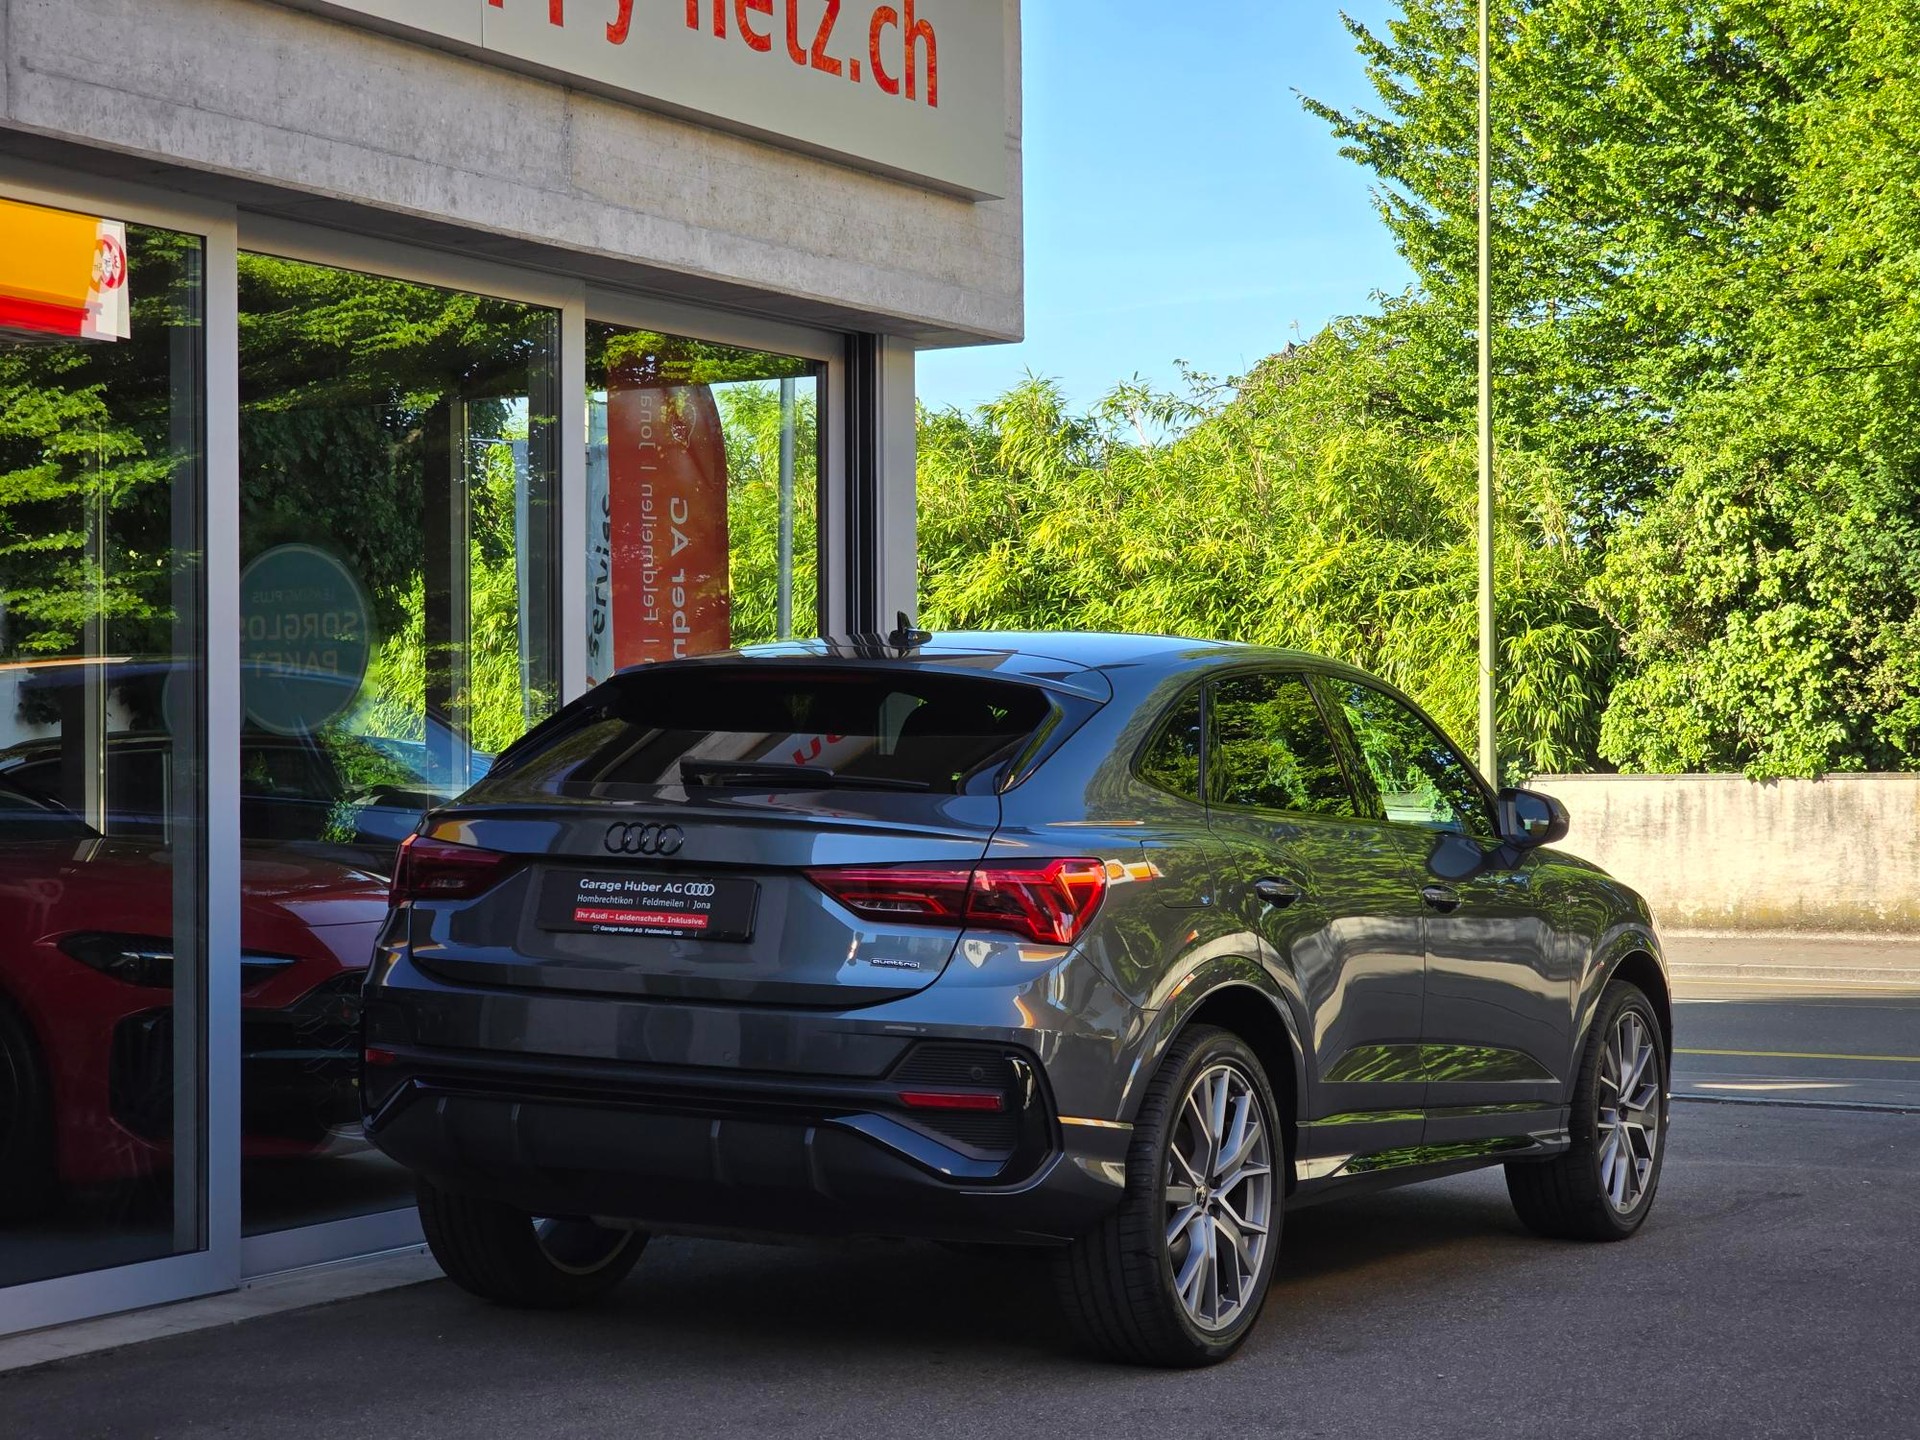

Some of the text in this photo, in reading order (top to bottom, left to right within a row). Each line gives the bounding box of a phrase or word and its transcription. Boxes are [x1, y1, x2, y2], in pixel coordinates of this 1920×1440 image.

[579, 878, 682, 894] Garage Huber AG
[577, 894, 634, 905] Hombrechtikon
[642, 897, 684, 908] Feldmeilen
[692, 900, 711, 909] Jona
[589, 911, 608, 920] Audi
[615, 913, 666, 924] Leidenschaft.
[667, 916, 705, 926] Inklusive.
[872, 959, 917, 968] quattro
